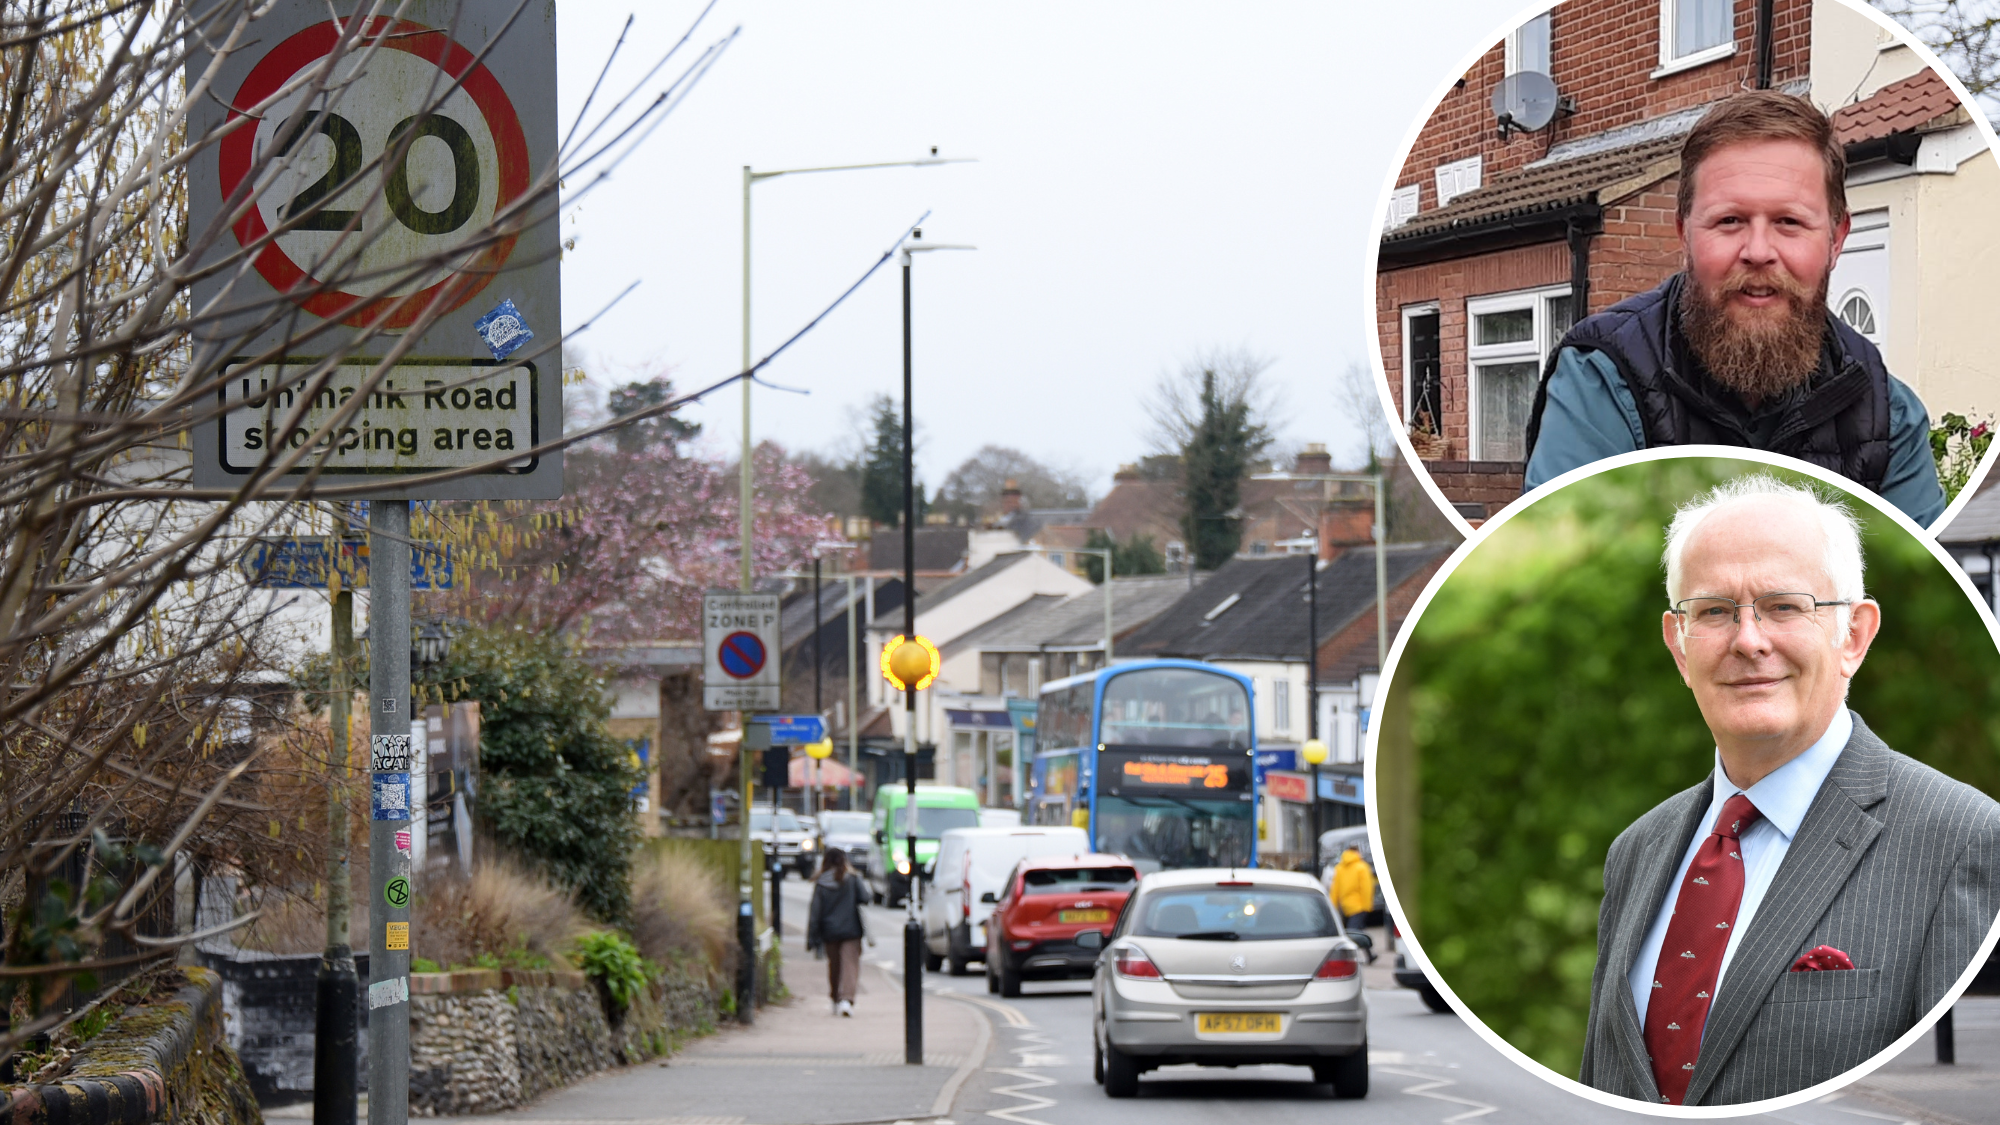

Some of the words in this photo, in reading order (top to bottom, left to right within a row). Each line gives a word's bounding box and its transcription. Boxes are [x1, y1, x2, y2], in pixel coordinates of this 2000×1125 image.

[272, 109, 481, 235] 20
[424, 380, 517, 410] Road
[433, 427, 514, 451] area
[708, 615, 758, 628] ZONE
[1204, 1014, 1241, 1031] AF57
